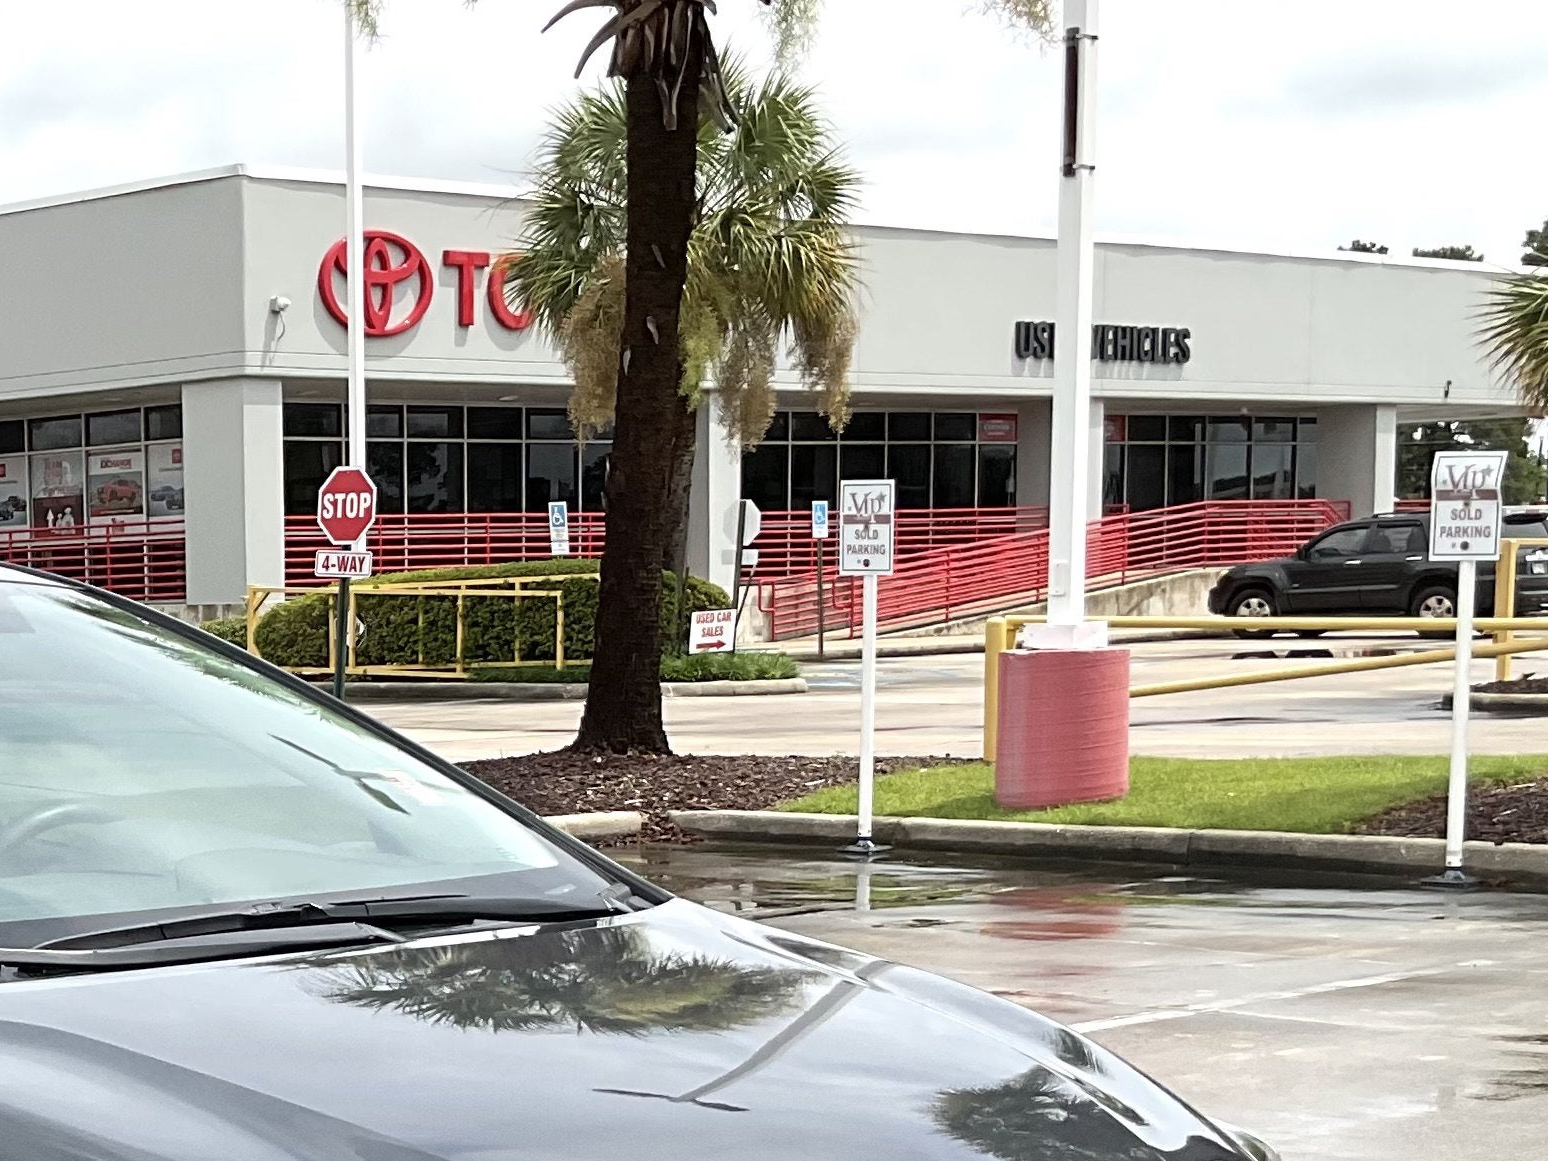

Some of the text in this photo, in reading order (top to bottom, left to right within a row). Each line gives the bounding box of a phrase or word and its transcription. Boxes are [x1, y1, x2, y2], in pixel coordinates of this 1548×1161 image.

[1015, 321, 1191, 364] US VEHICLES
[322, 492, 372, 519] STOP
[1450, 508, 1483, 521] SOLD
[854, 529, 879, 540] SOLD
[1439, 525, 1492, 538] PARKING
[846, 544, 886, 555] PARKING
[321, 555, 366, 573] 4-WAY
[696, 611, 732, 624] USED CAR
[701, 625, 724, 637] SALES
